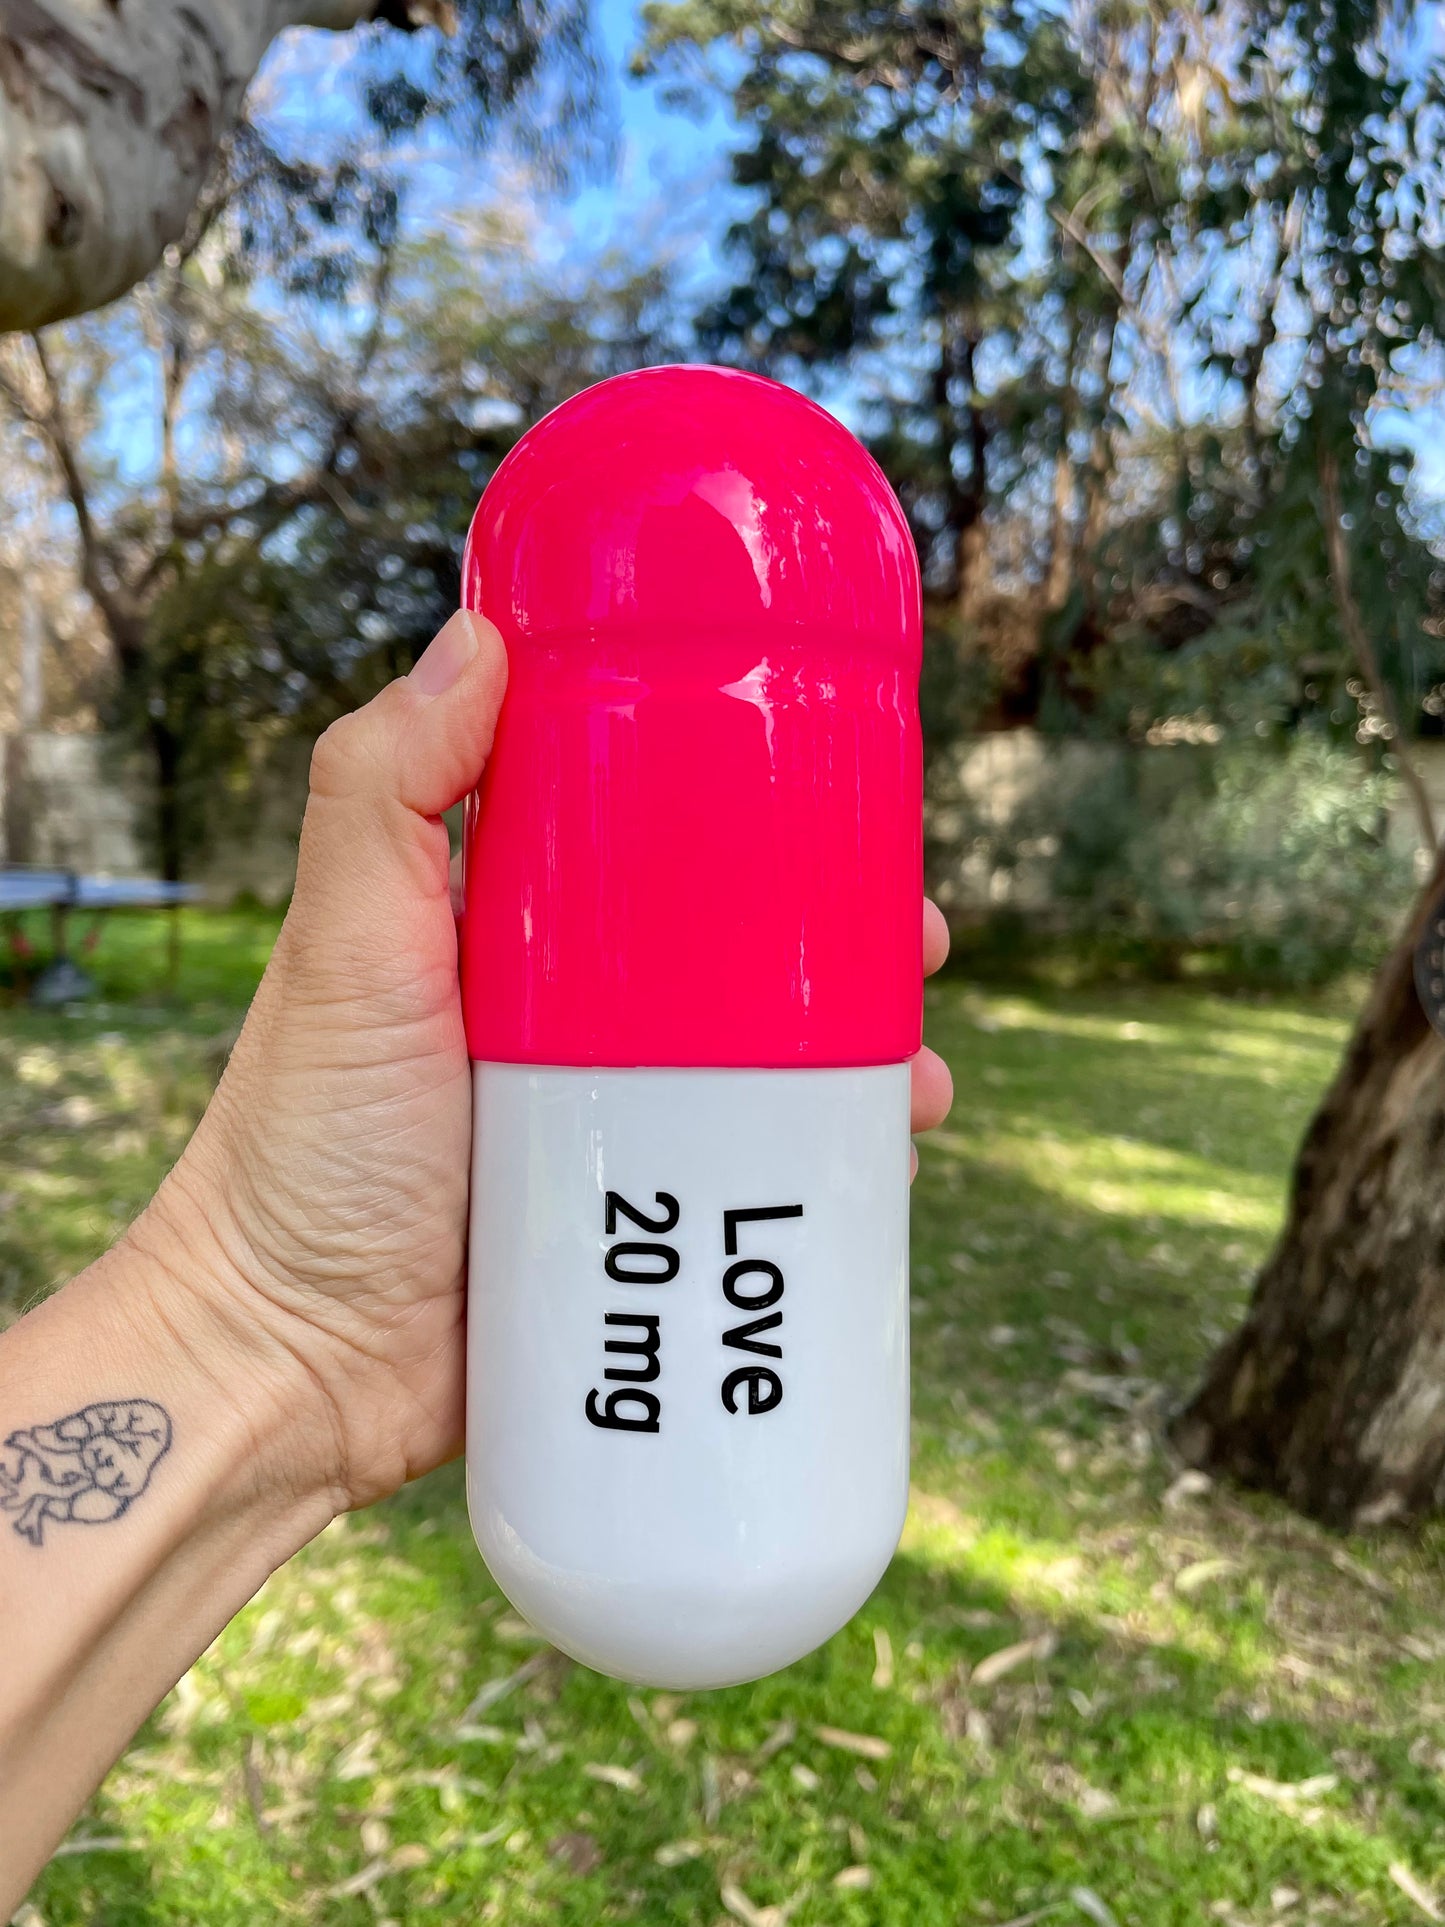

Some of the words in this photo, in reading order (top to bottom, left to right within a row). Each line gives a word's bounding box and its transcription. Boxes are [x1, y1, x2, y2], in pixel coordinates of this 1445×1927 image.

[604, 1191, 681, 1285] 20
[721, 1204, 804, 1415] Love
[585, 1312, 661, 1434] mg
